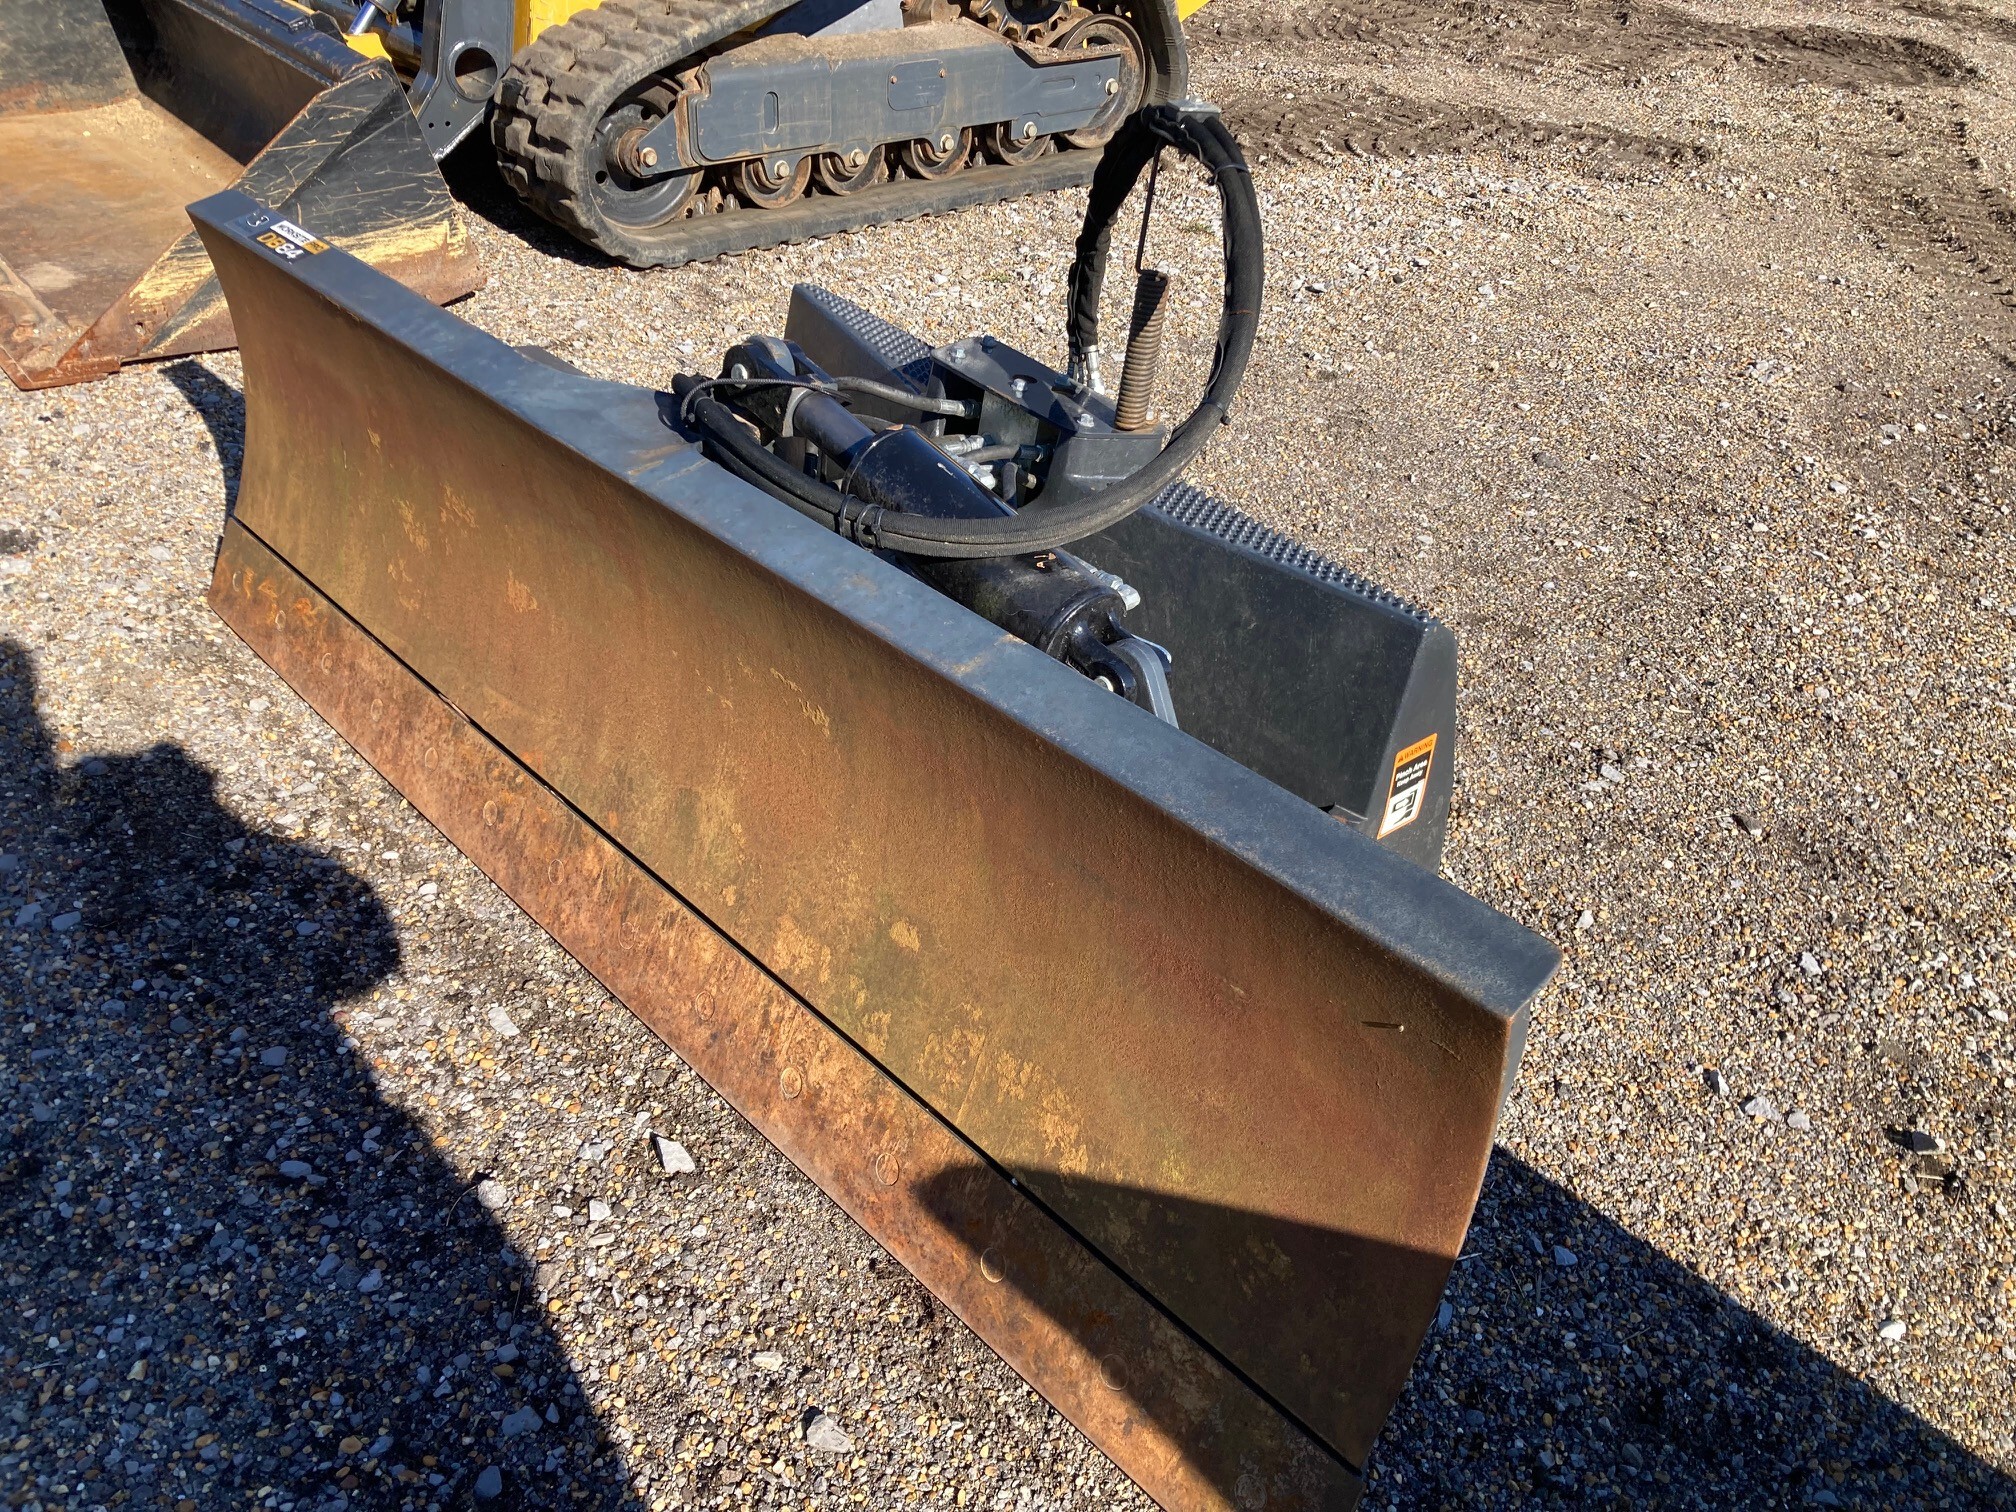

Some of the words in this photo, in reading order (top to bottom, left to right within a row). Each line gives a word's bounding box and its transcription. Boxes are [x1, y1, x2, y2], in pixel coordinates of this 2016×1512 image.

[257, 232, 304, 259] DB84
[1404, 740, 1433, 759] WARNING
[1395, 767, 1413, 781] Pinch
[1413, 759, 1428, 772] Area
